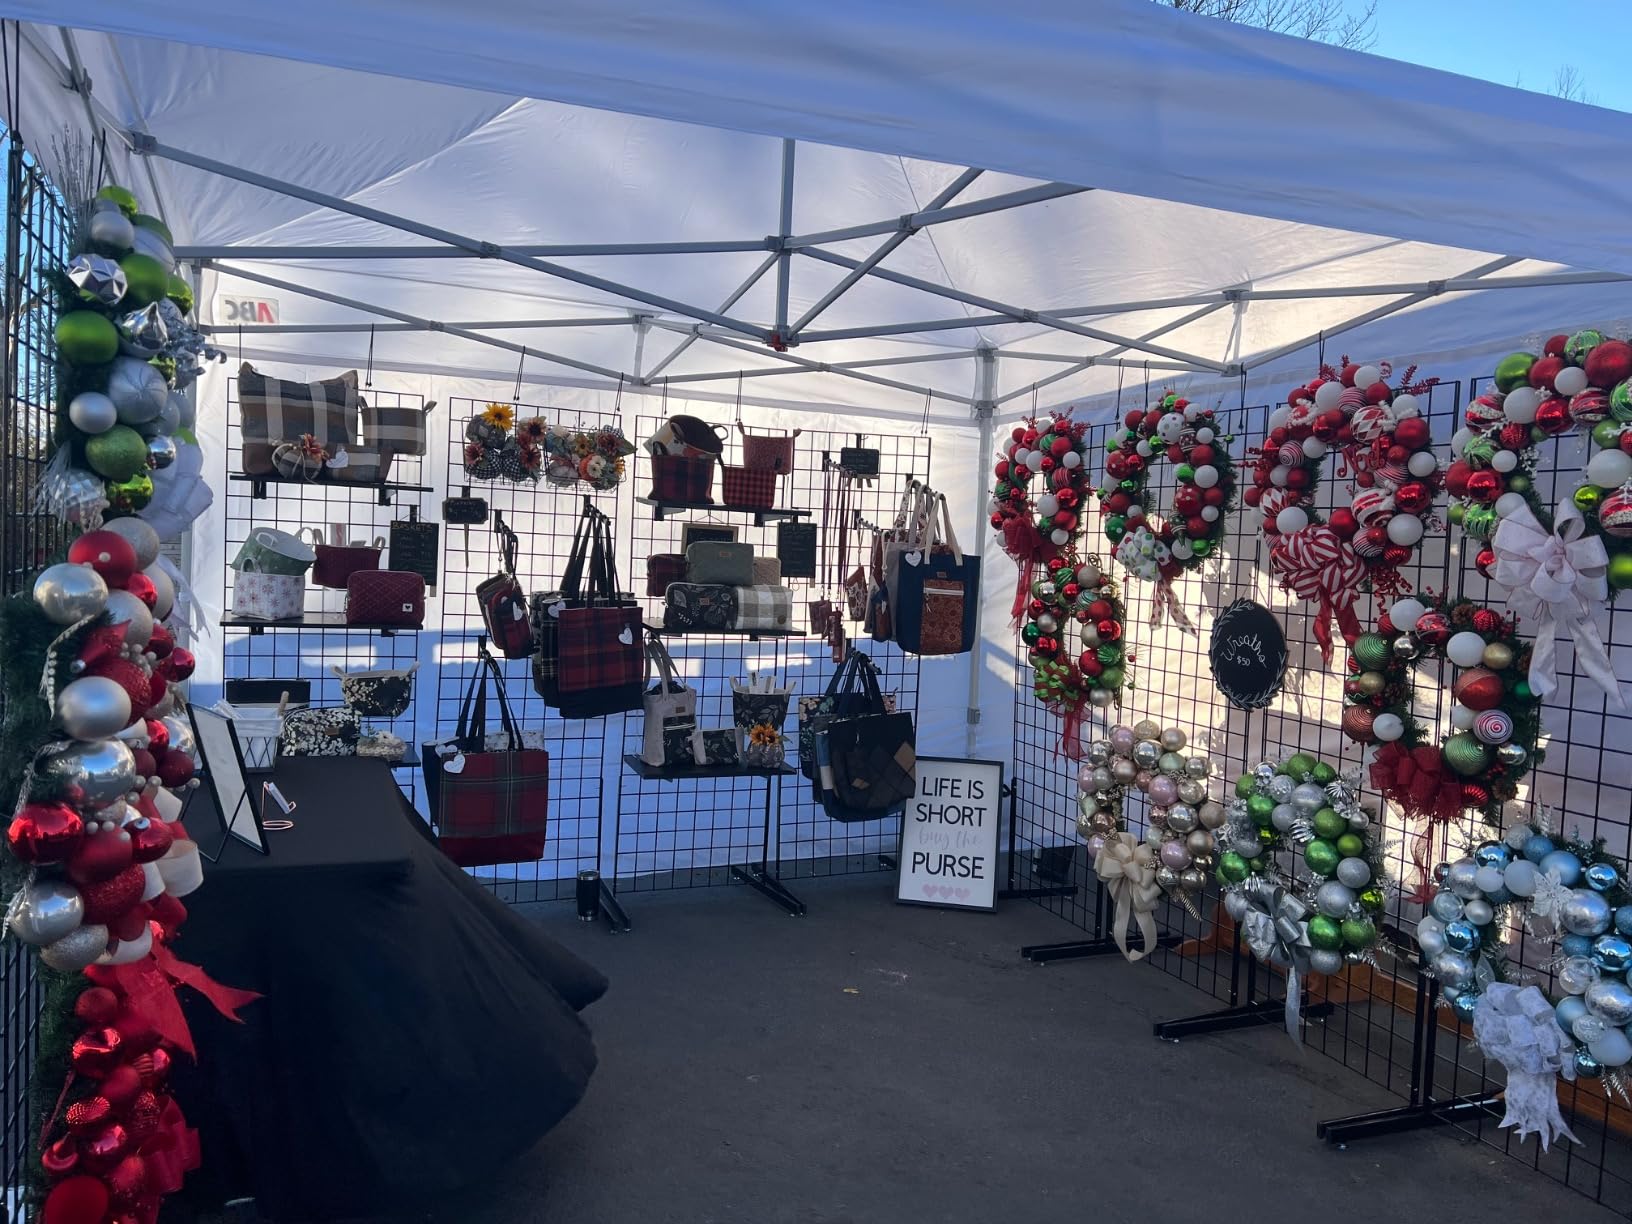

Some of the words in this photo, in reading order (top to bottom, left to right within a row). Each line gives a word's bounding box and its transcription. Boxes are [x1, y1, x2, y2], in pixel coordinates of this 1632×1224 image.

[1337, 437, 1387, 478] Noel
[1220, 633, 1268, 668] Wreaths
[1236, 655, 1251, 667] $50
[922, 776, 962, 799] LIFE
[967, 779, 985, 799] IS
[915, 802, 987, 827] SHORT
[919, 827, 950, 850] buy
[956, 830, 982, 849] the
[911, 851, 985, 880] PURSE
